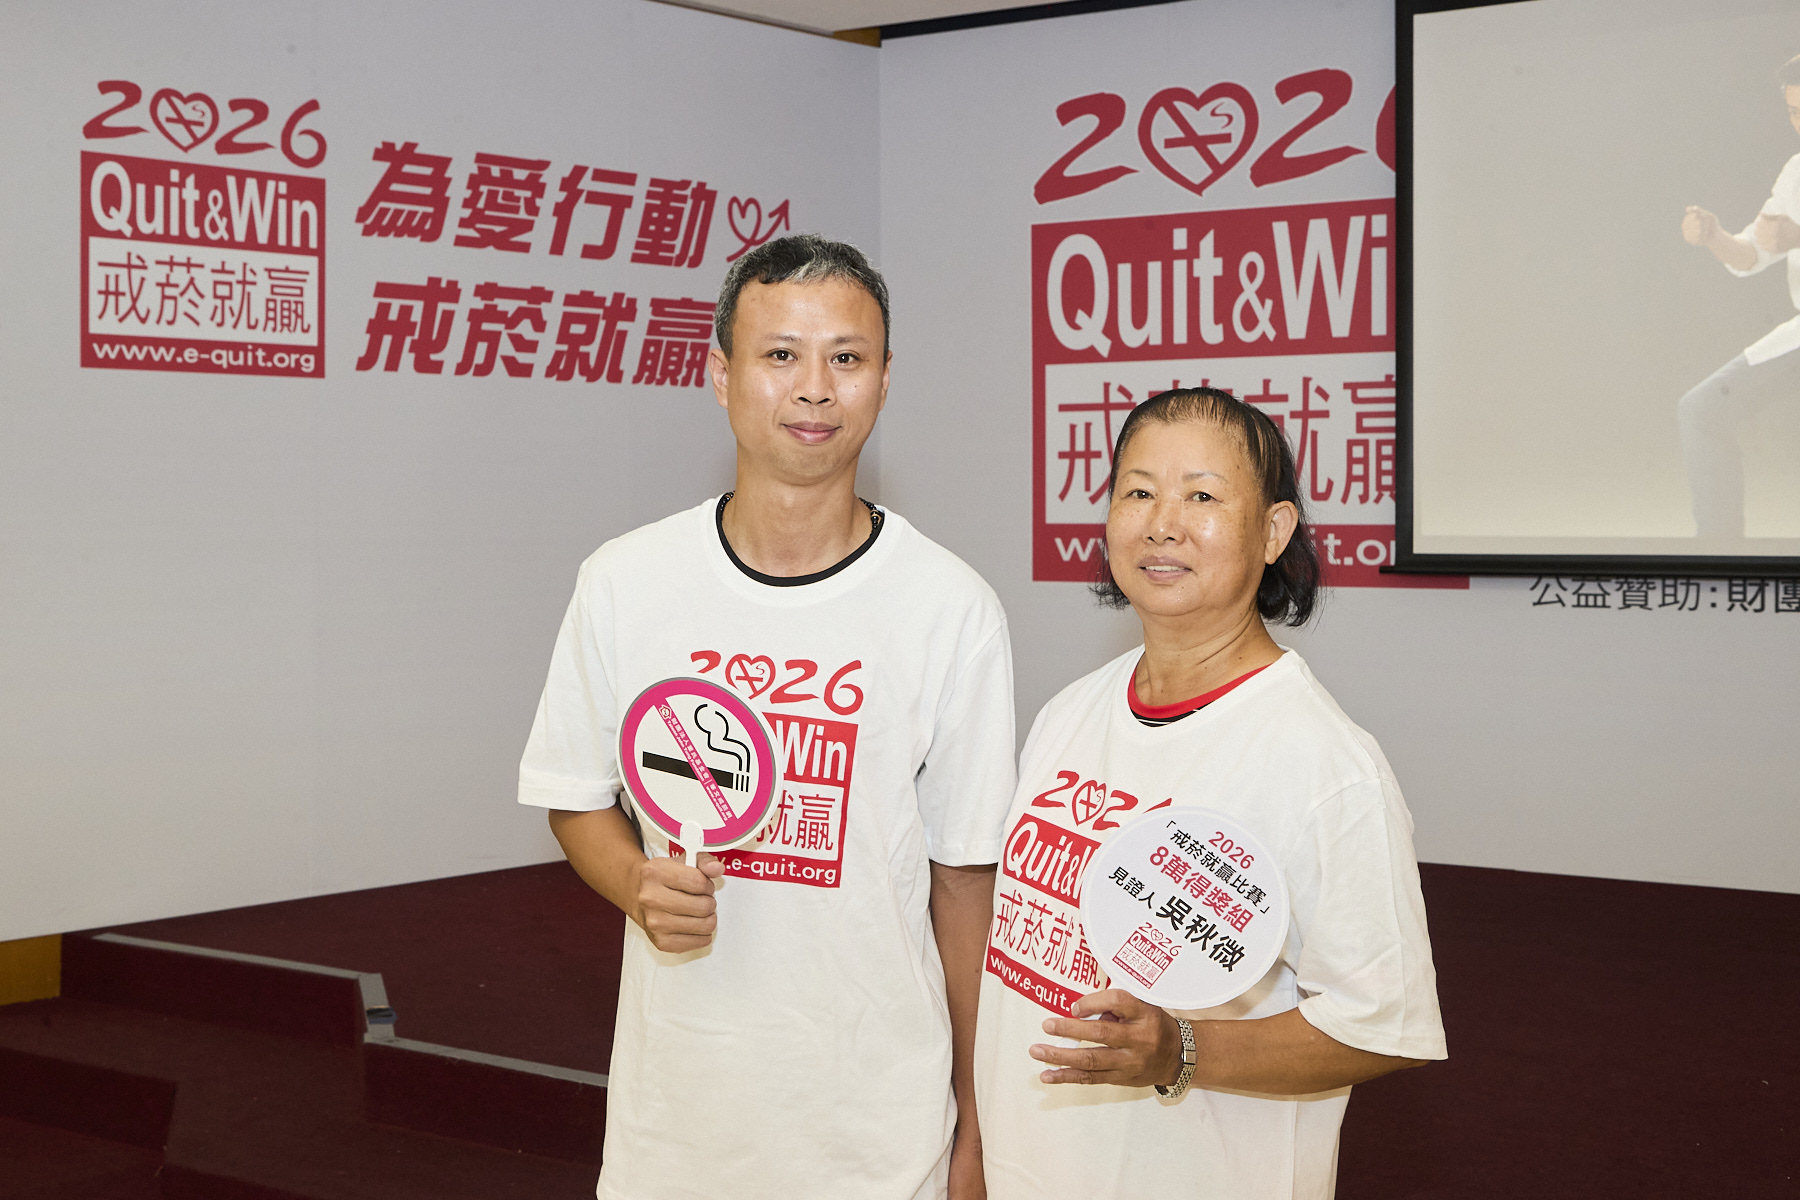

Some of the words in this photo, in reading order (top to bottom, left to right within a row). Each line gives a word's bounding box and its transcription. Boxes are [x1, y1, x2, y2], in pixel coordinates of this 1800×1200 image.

[90, 160, 319, 249] Quit&Win
[355, 141, 718, 269] 為愛行動
[97, 252, 312, 334] 戒菸就贏
[1046, 213, 1390, 358] Quit&Wi
[92, 341, 316, 373] www.e-quit.org
[355, 276, 717, 389] 戒菸就贏
[1031, 770, 1172, 830] 202
[1108, 866, 1156, 910] 見證人
[1149, 846, 1254, 933] 8萬得獎組
[1208, 831, 1255, 870] 2026
[1129, 933, 1170, 970] Quit&Win
